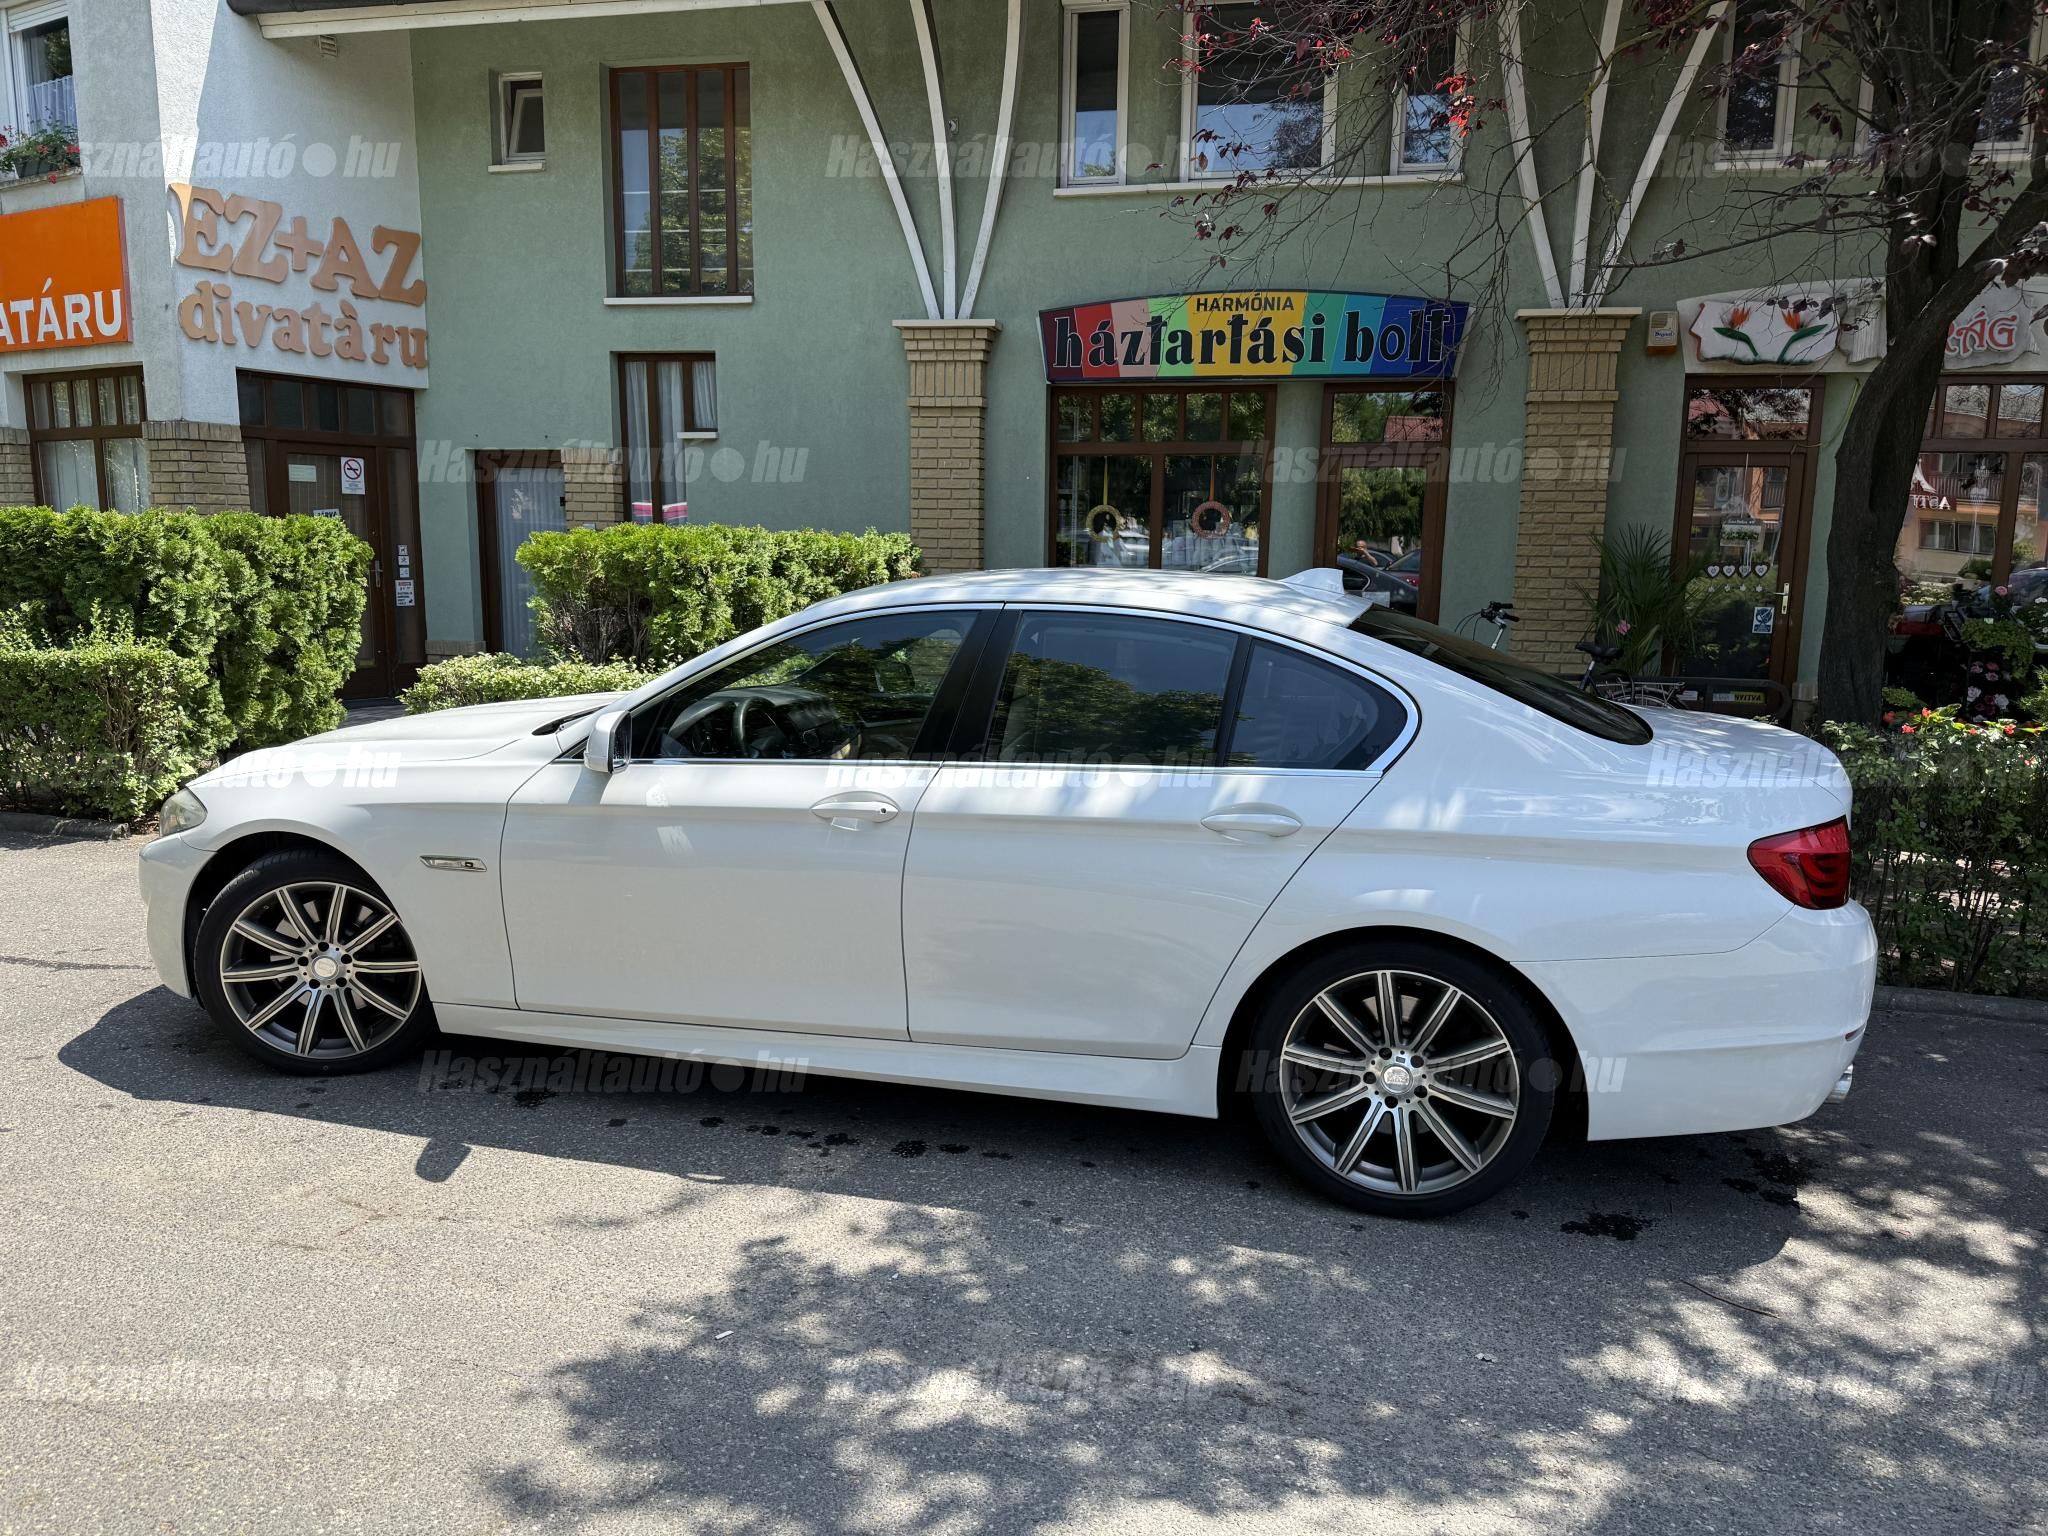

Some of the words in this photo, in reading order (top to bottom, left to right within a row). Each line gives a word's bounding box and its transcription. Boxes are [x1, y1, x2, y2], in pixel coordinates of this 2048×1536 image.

[168, 183, 427, 306] EZ+AZ
[1196, 293, 1295, 312] HARMÓNIA
[1053, 311, 1326, 368] háztartási
[1343, 309, 1451, 364] bolt
